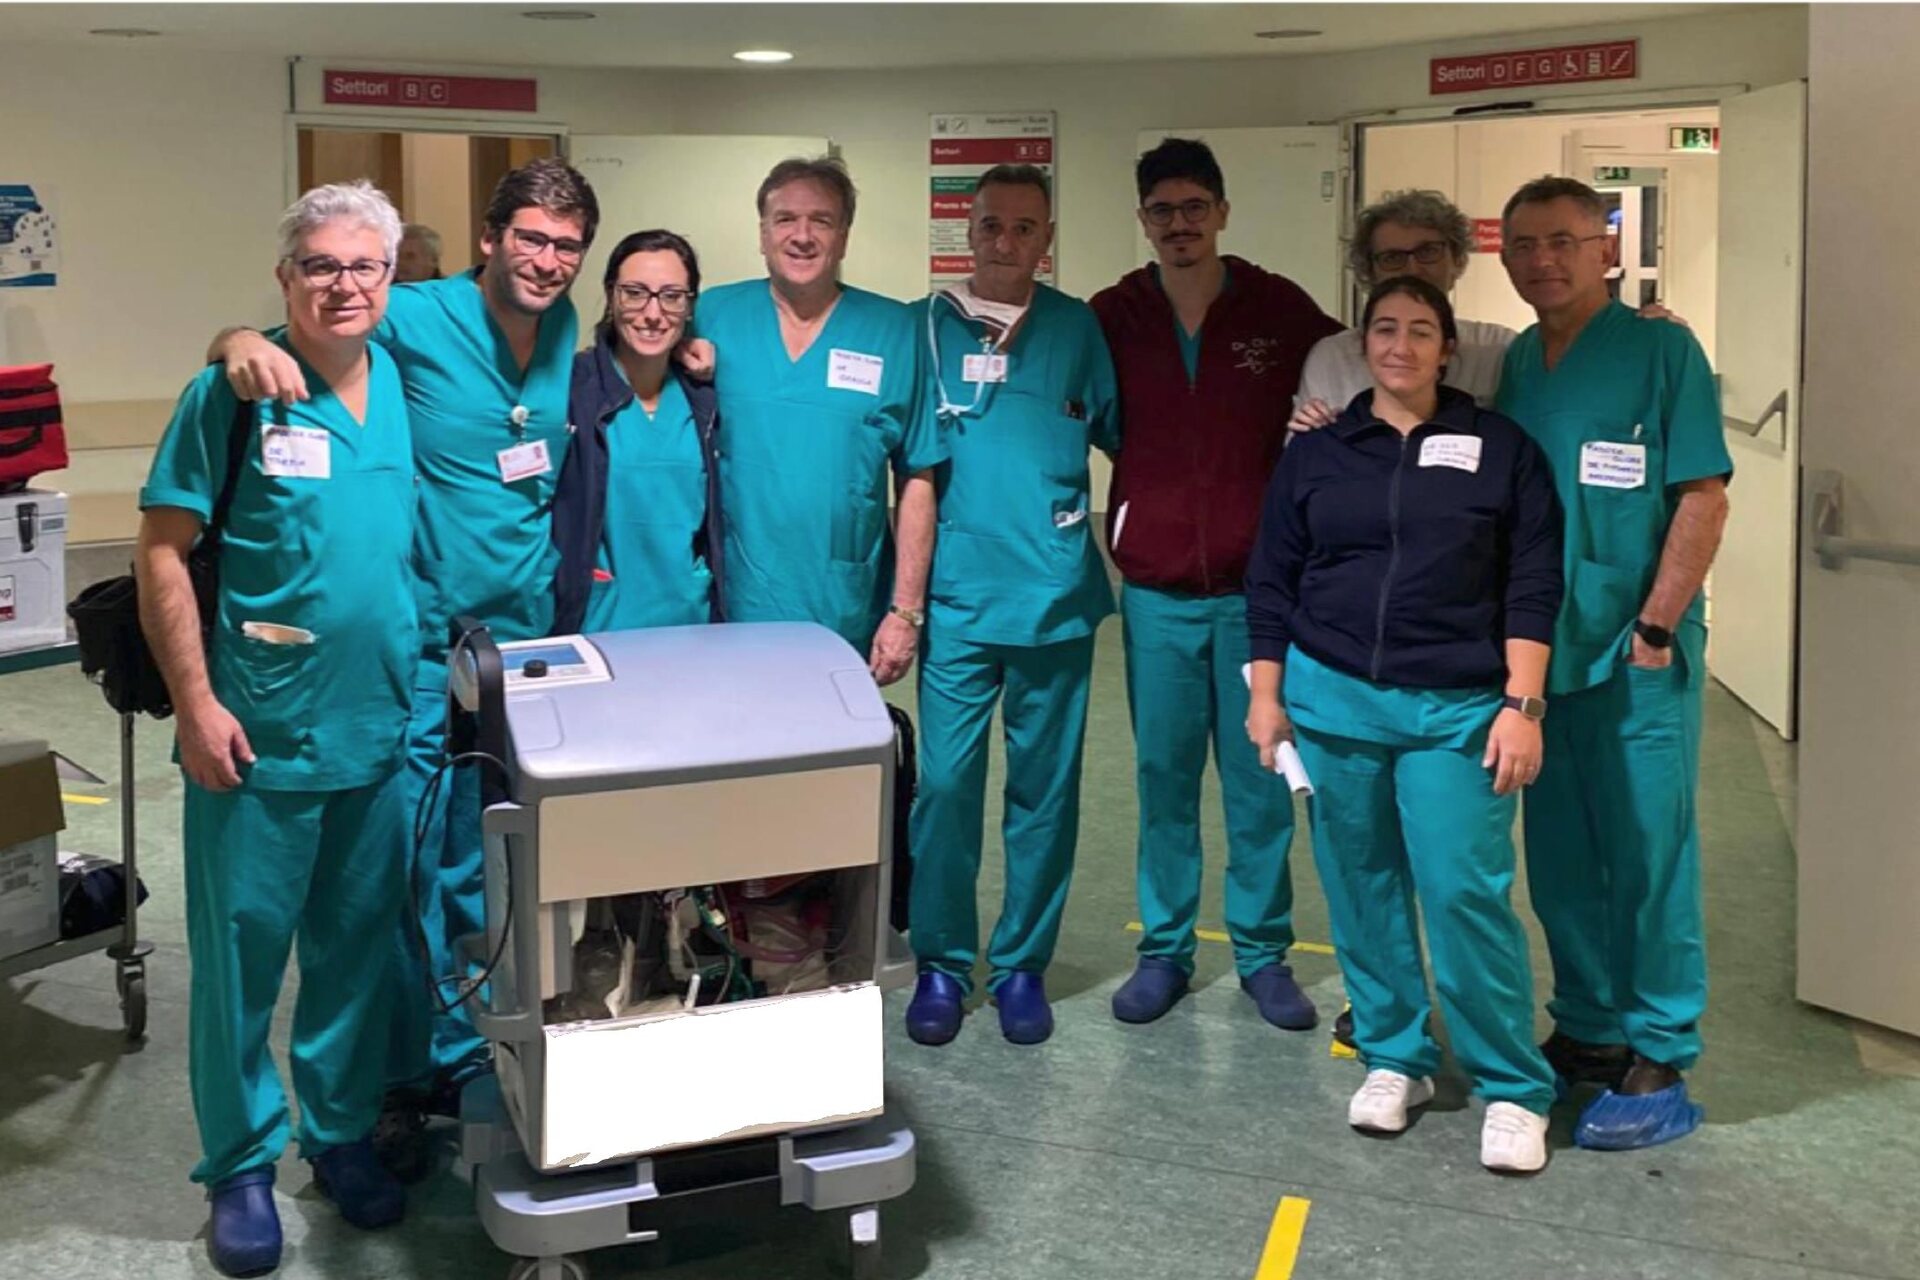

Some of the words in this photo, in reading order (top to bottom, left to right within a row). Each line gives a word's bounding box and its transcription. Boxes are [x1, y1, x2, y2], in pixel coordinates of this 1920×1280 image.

[1437, 64, 1485, 83] Settori
[1494, 64, 1505, 78] D
[1516, 62, 1525, 75] F
[1539, 59, 1551, 74] G
[332, 77, 389, 96] Settori
[406, 83, 418, 98] B
[430, 84, 443, 99] C
